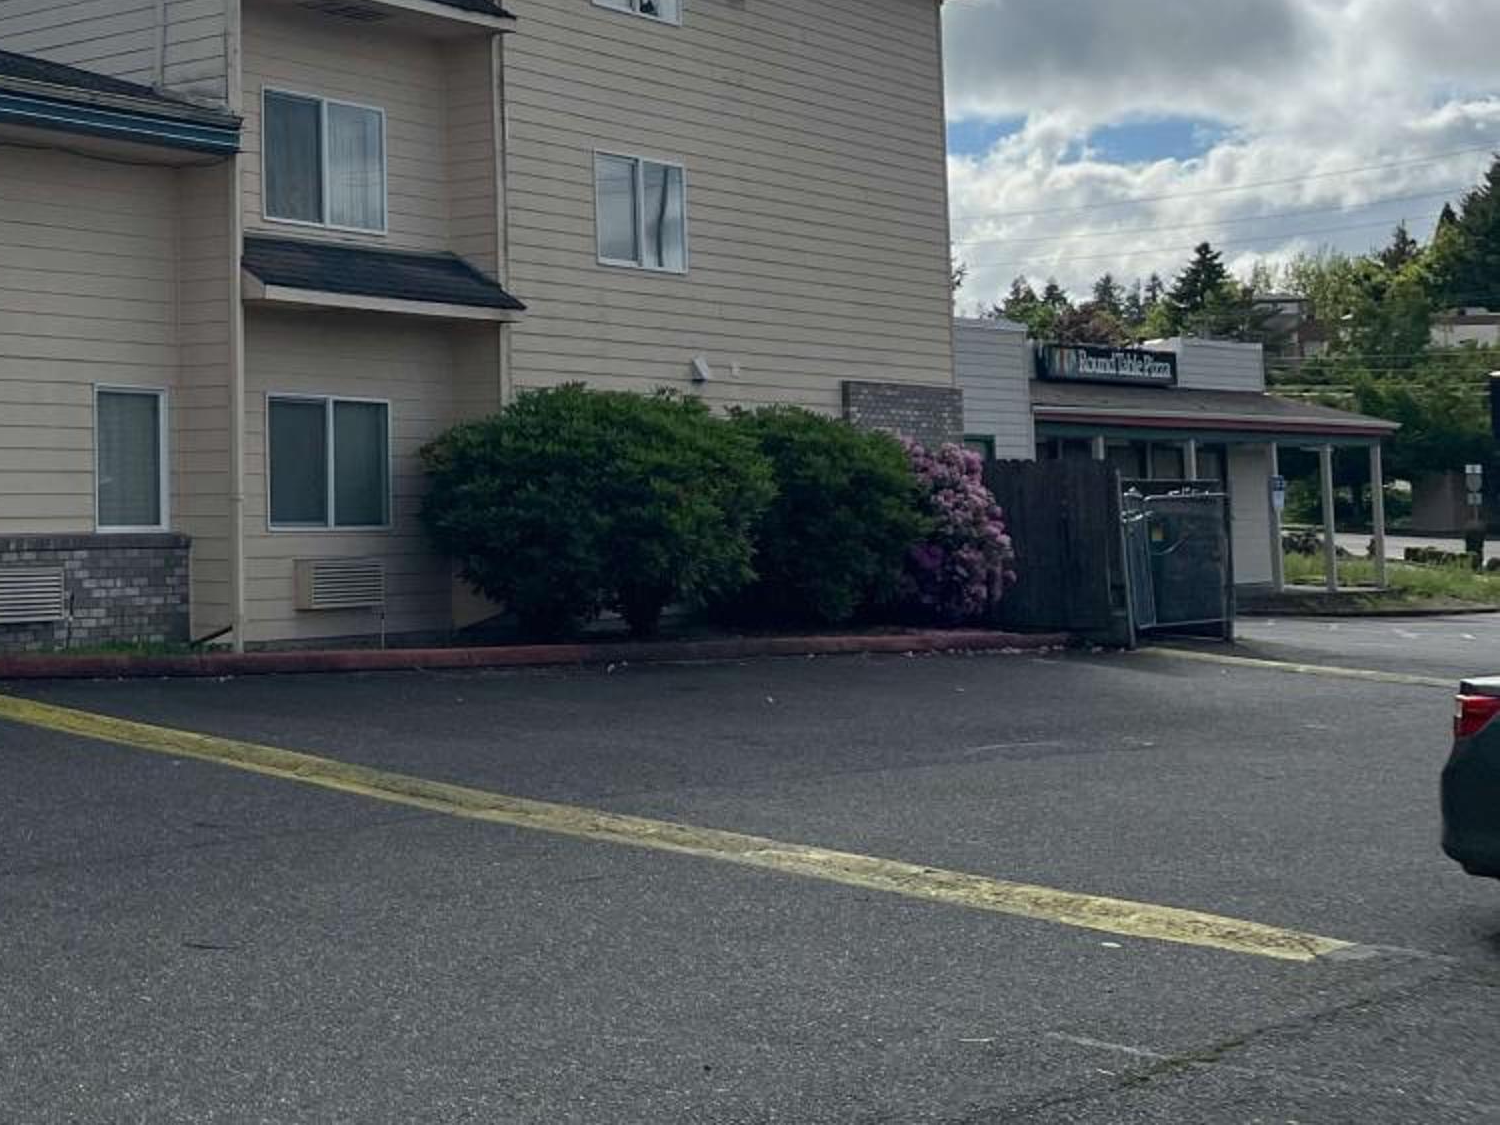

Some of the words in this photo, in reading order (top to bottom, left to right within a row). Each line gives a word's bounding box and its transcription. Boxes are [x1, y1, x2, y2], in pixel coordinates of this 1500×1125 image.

[1078, 349, 1116, 374] Round
[1115, 352, 1143, 376] Table
[1143, 354, 1171, 378] Pizza
